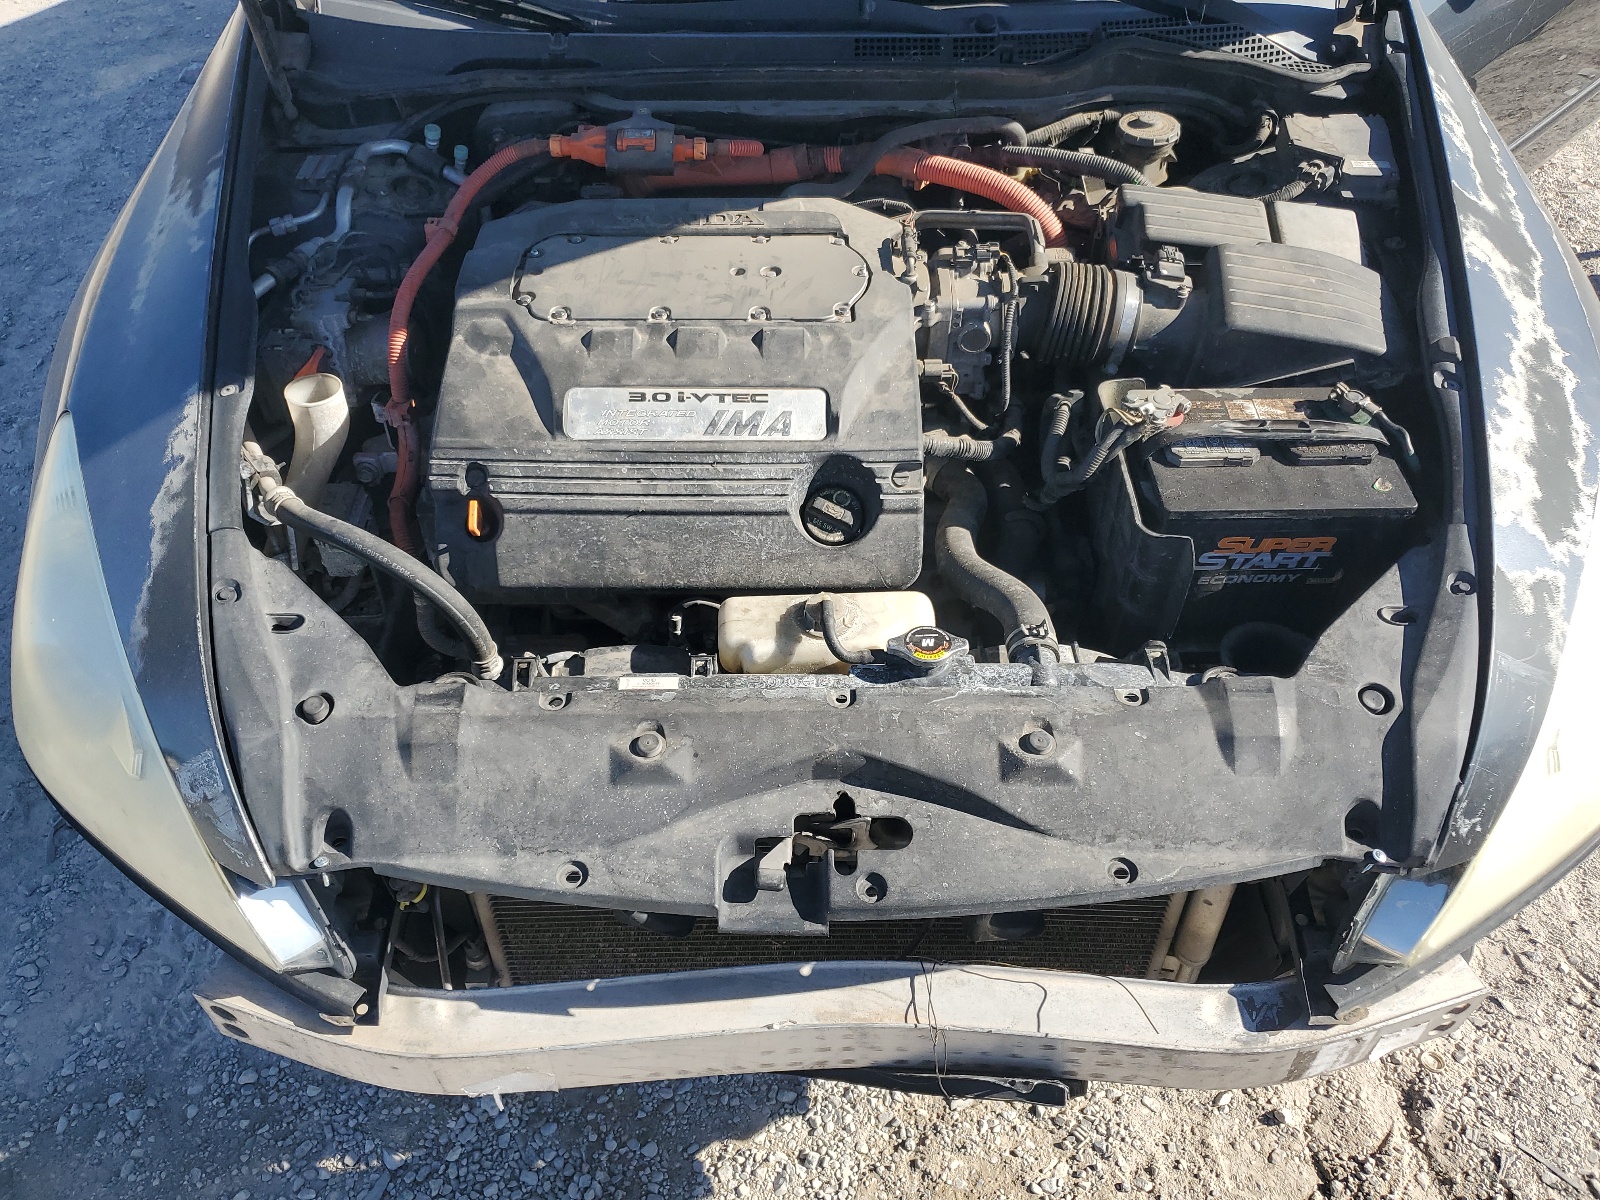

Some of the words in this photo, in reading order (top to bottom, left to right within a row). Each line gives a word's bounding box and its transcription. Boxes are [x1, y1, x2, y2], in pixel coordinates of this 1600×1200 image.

[628, 391, 672, 403] 3.0
[677, 391, 769, 403] i-VTEC
[601, 409, 697, 418] INTEGRATED
[597, 418, 651, 427] MOTOR
[702, 409, 793, 437] IMA
[594, 427, 649, 436] ASSIST
[1214, 536, 1338, 554] SUPER
[1198, 552, 1333, 570] START
[1197, 573, 1301, 585] ECONOMY
